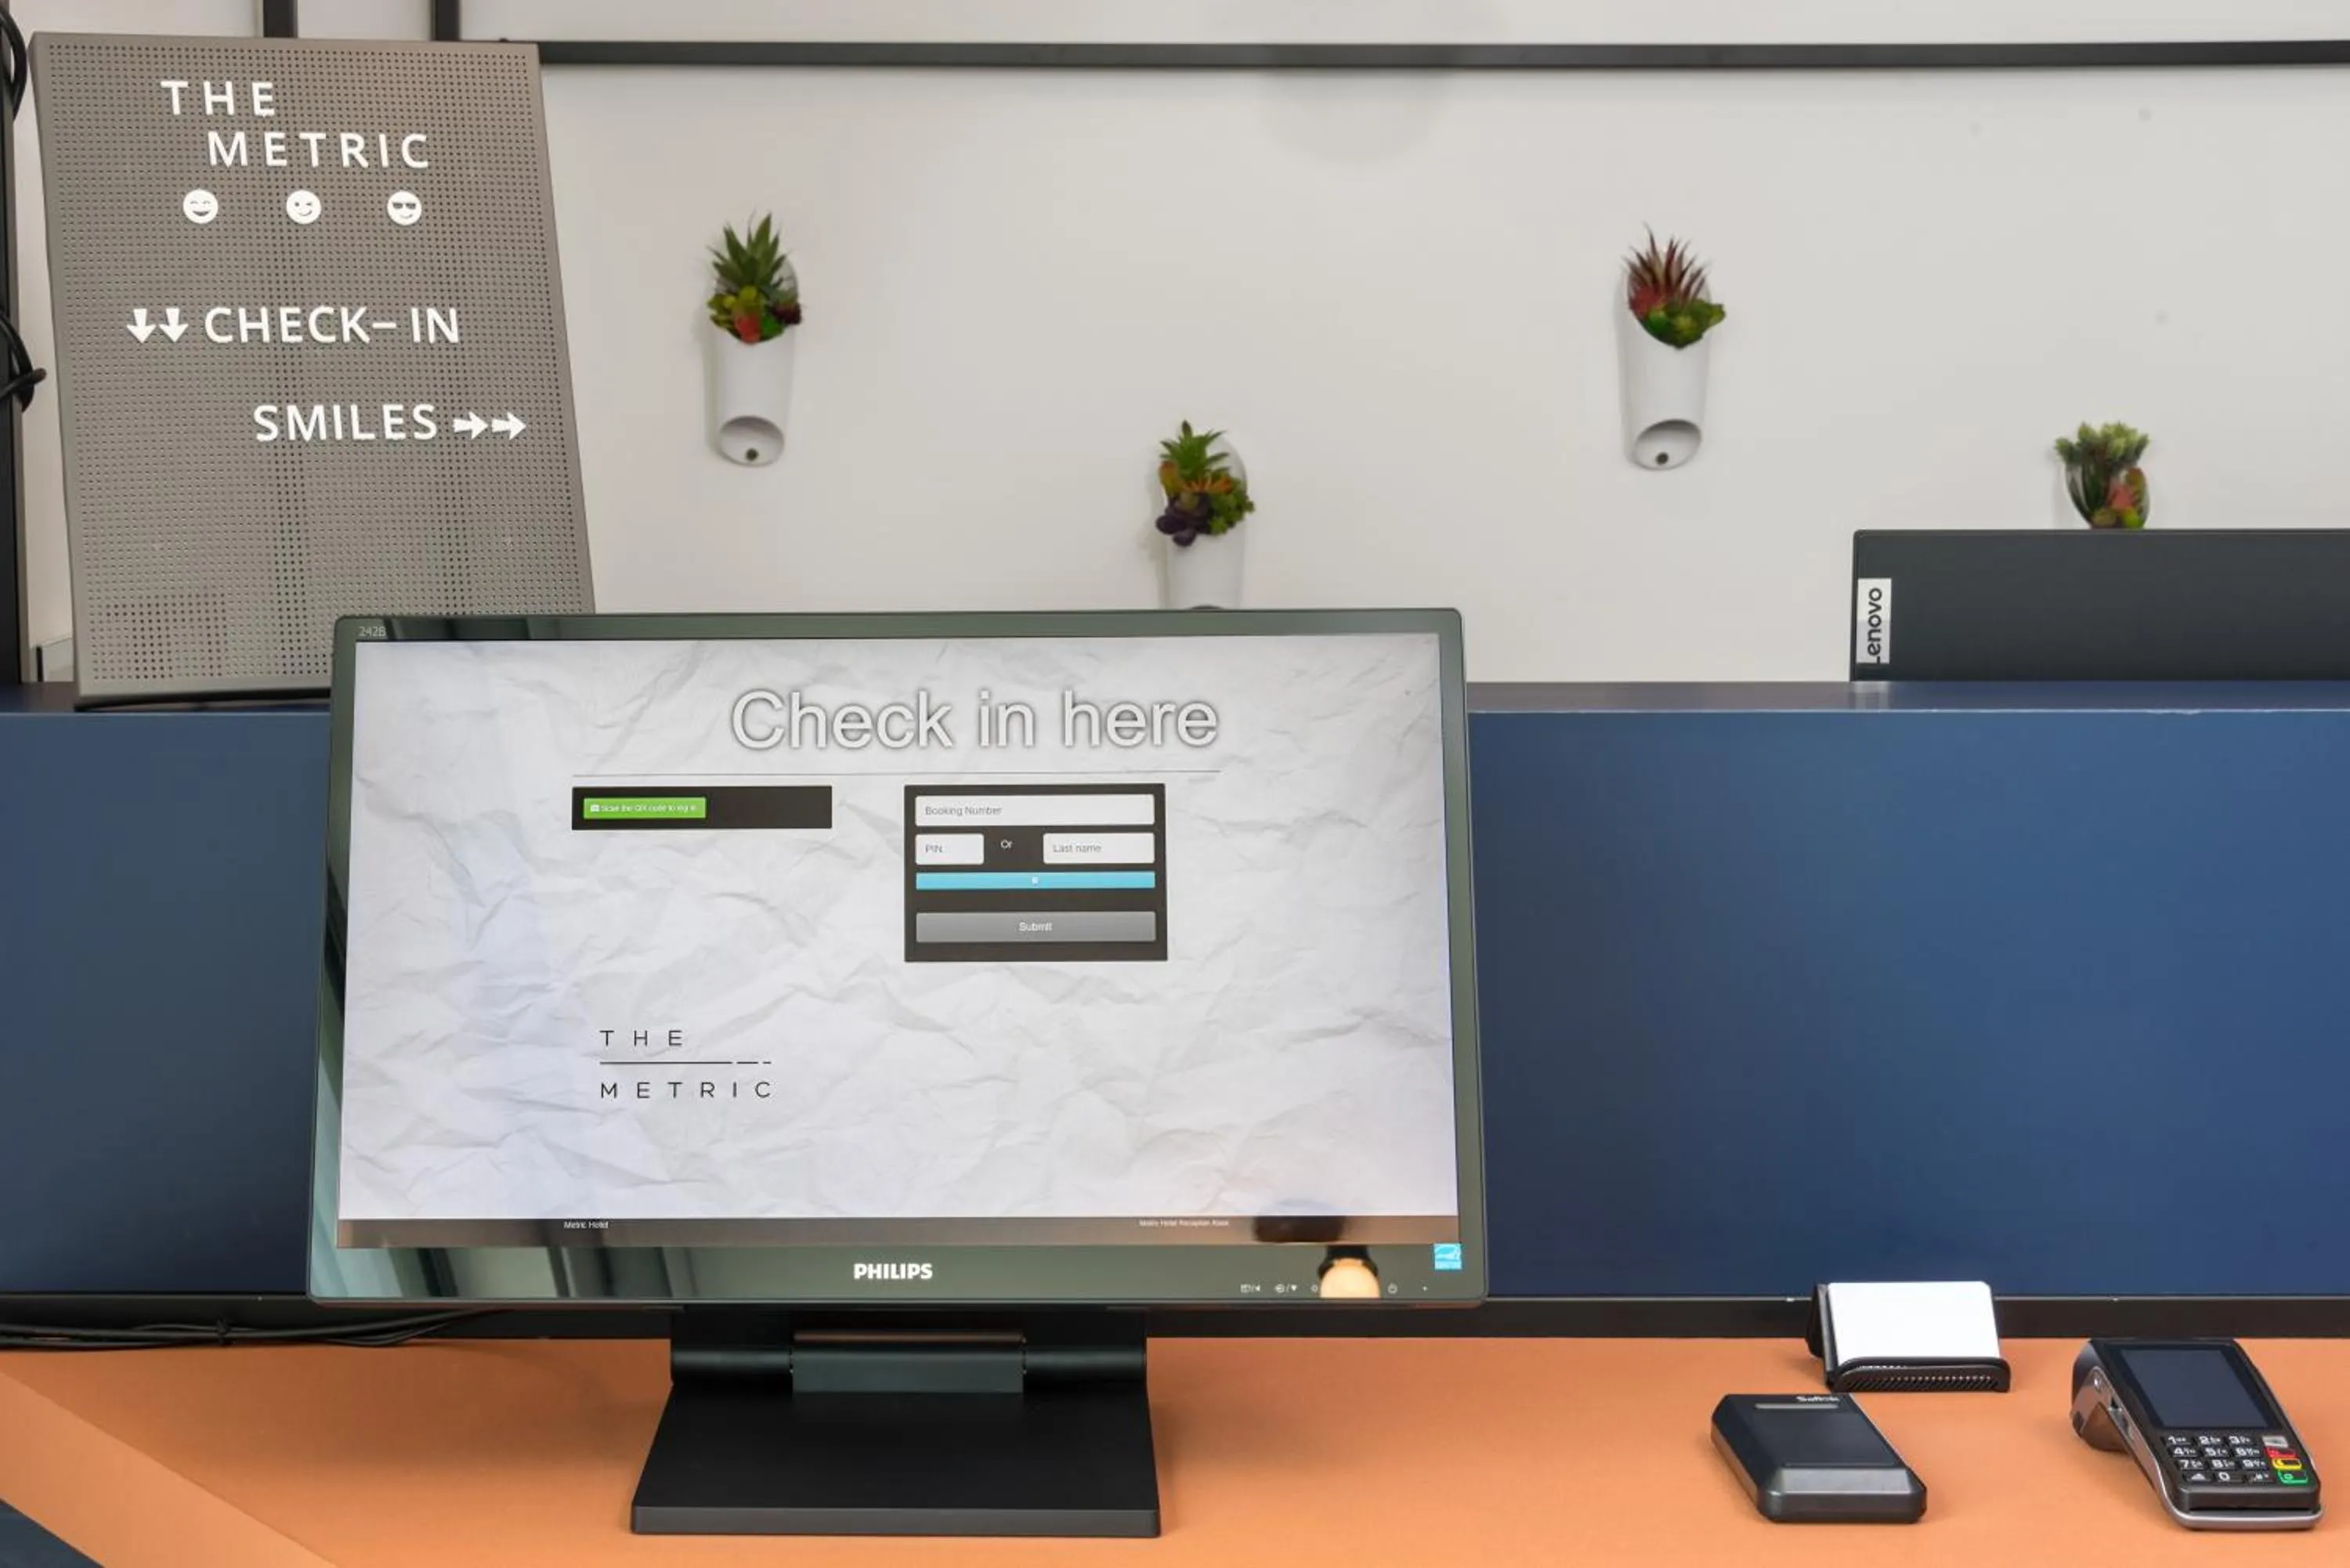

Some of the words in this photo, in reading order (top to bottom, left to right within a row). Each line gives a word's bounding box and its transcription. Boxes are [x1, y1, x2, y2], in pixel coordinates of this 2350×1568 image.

[161, 81, 276, 117] THE
[208, 131, 429, 168] METRIC
[253, 403, 437, 442] SMILES
[732, 688, 953, 749] Check
[978, 688, 1036, 748] in
[1063, 688, 1219, 748] here
[925, 806, 963, 817] Booking
[965, 806, 1002, 815] Number
[925, 844, 944, 854] PIN
[1053, 844, 1072, 854] Last
[1019, 922, 1053, 932] Submit
[600, 1030, 682, 1046] THE
[601, 1082, 771, 1099] METRIC
[854, 1263, 933, 1280] PHILIPS
